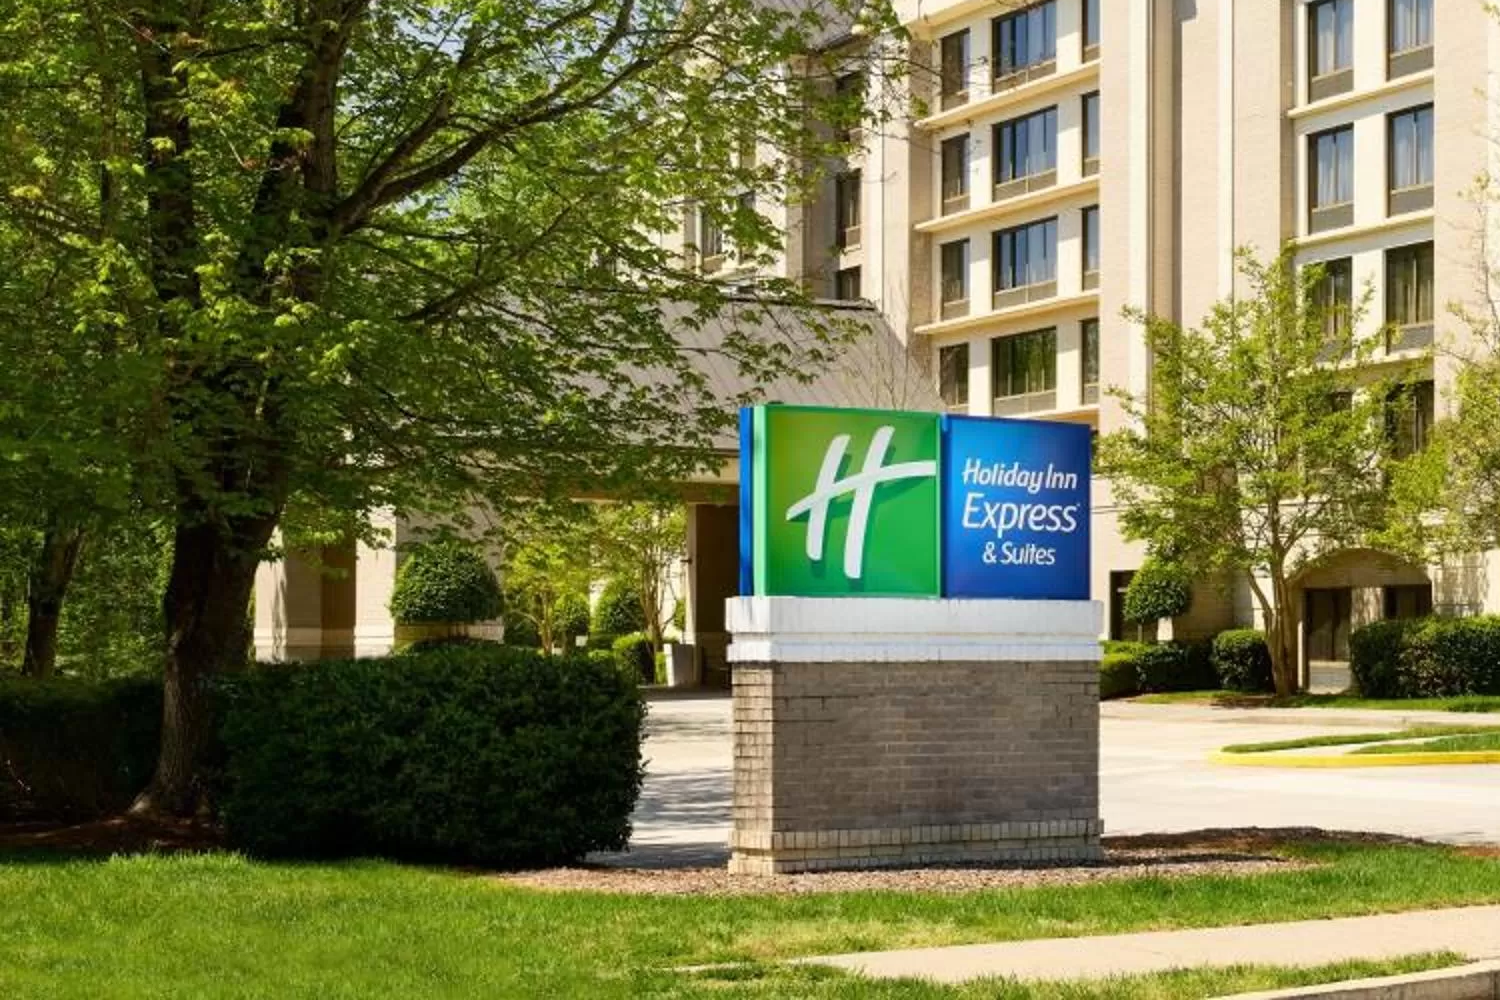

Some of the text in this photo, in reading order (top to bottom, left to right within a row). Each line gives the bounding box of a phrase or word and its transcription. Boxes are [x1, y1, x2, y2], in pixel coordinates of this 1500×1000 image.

[961, 457, 1078, 494] Holiday Inn
[785, 425, 937, 579] H
[962, 491, 1078, 539] Express
[982, 541, 1056, 567] & Suites
